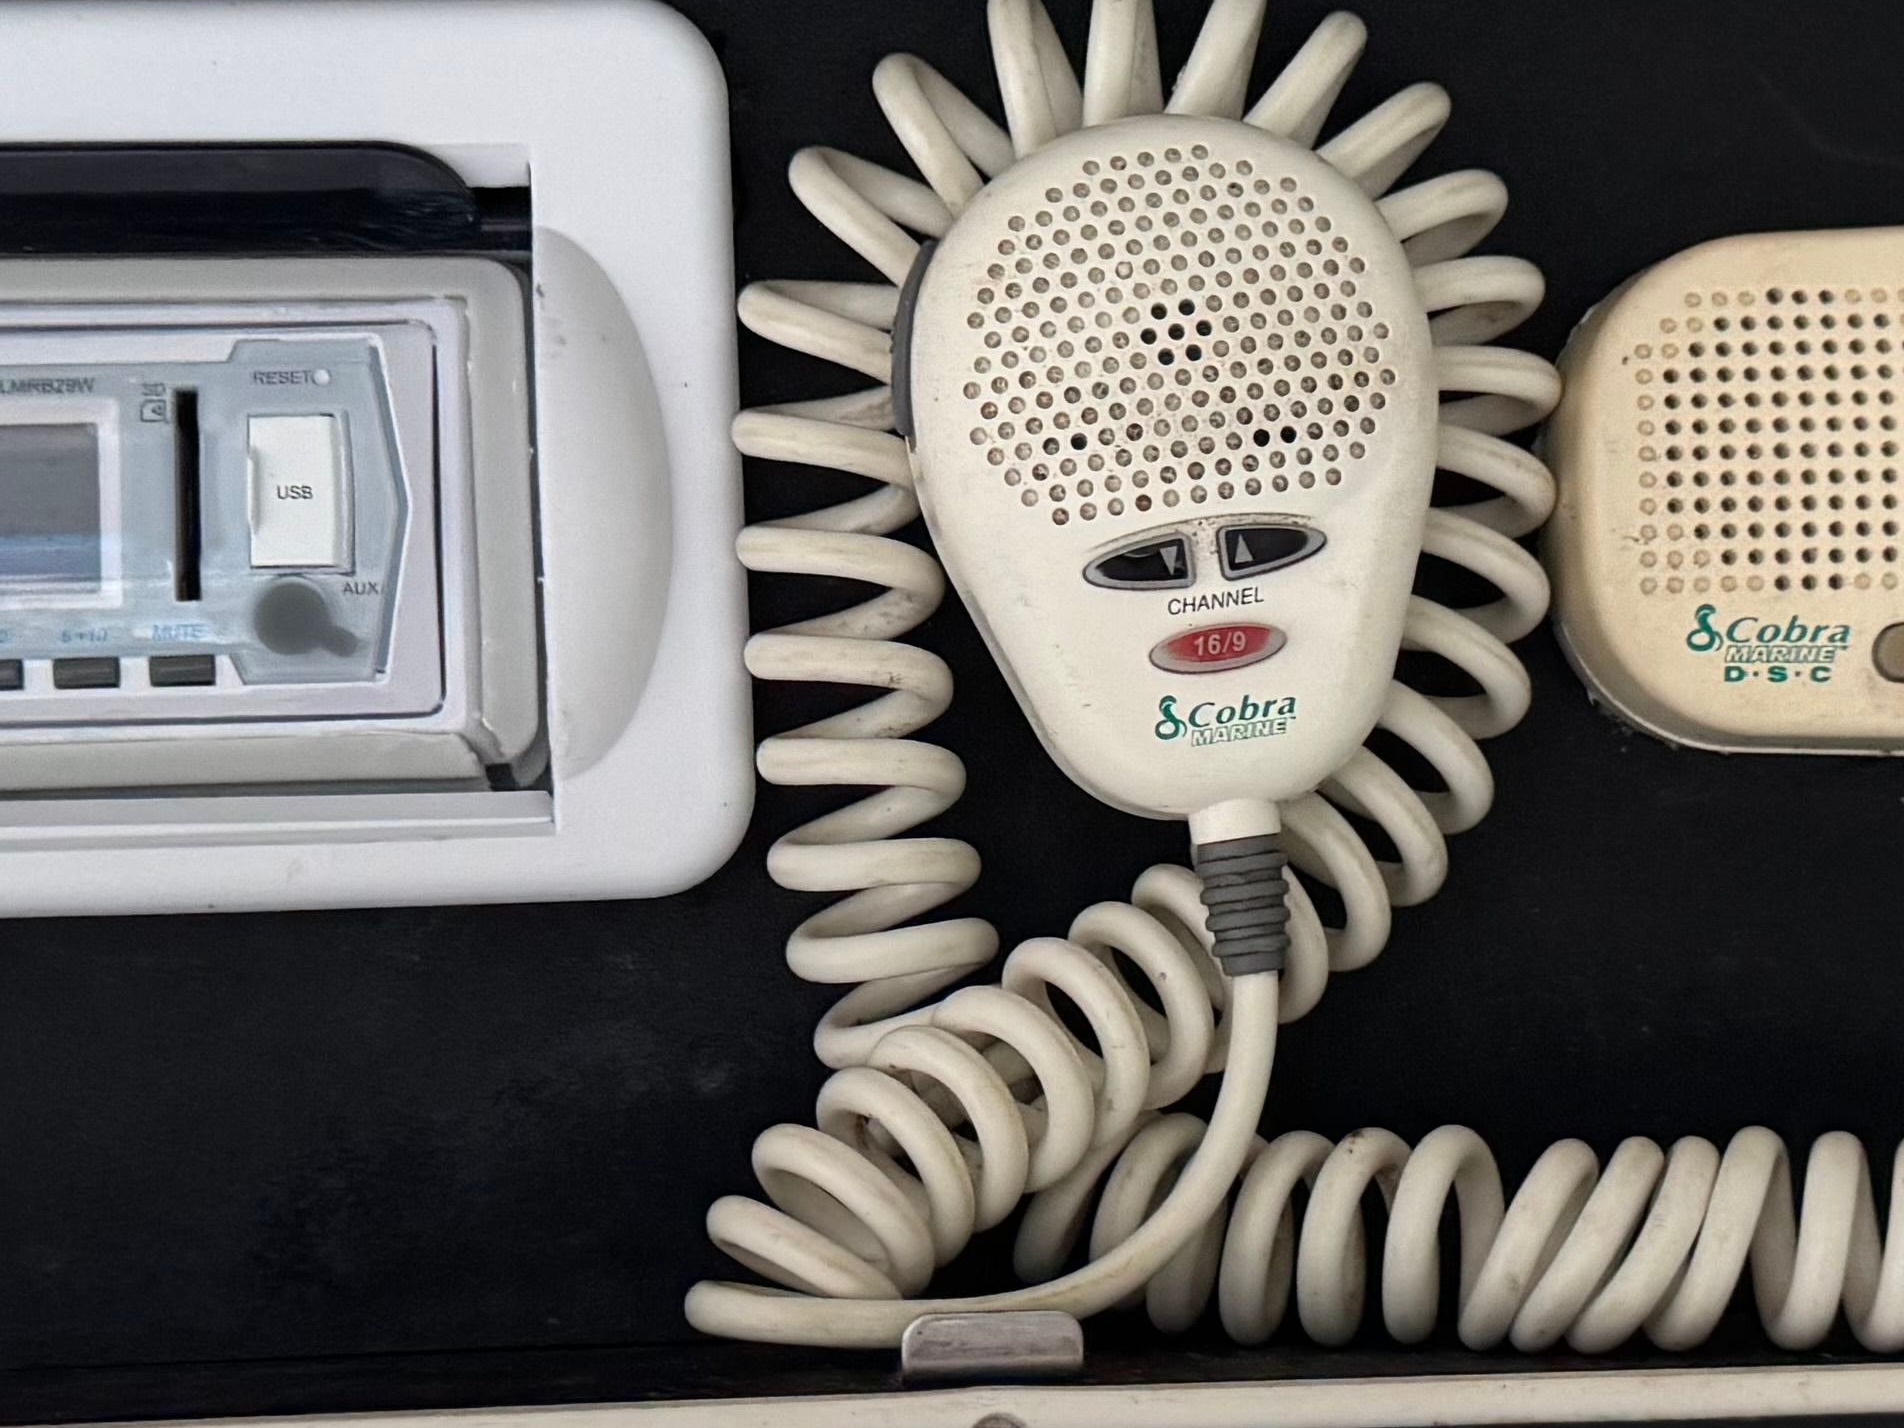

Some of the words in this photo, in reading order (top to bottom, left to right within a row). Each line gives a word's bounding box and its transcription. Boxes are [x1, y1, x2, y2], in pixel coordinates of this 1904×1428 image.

[252, 369, 314, 386] RESET
[141, 381, 166, 398] SD
[276, 484, 314, 500] USB
[342, 581, 380, 596] AUX
[1167, 585, 1265, 616] CHANNEL
[1724, 614, 1852, 644] Cobra
[1193, 631, 1247, 658] 16/9
[1724, 644, 1837, 664] MARINE
[1188, 693, 1297, 728] Cobra
[1190, 717, 1289, 748] MARINE
